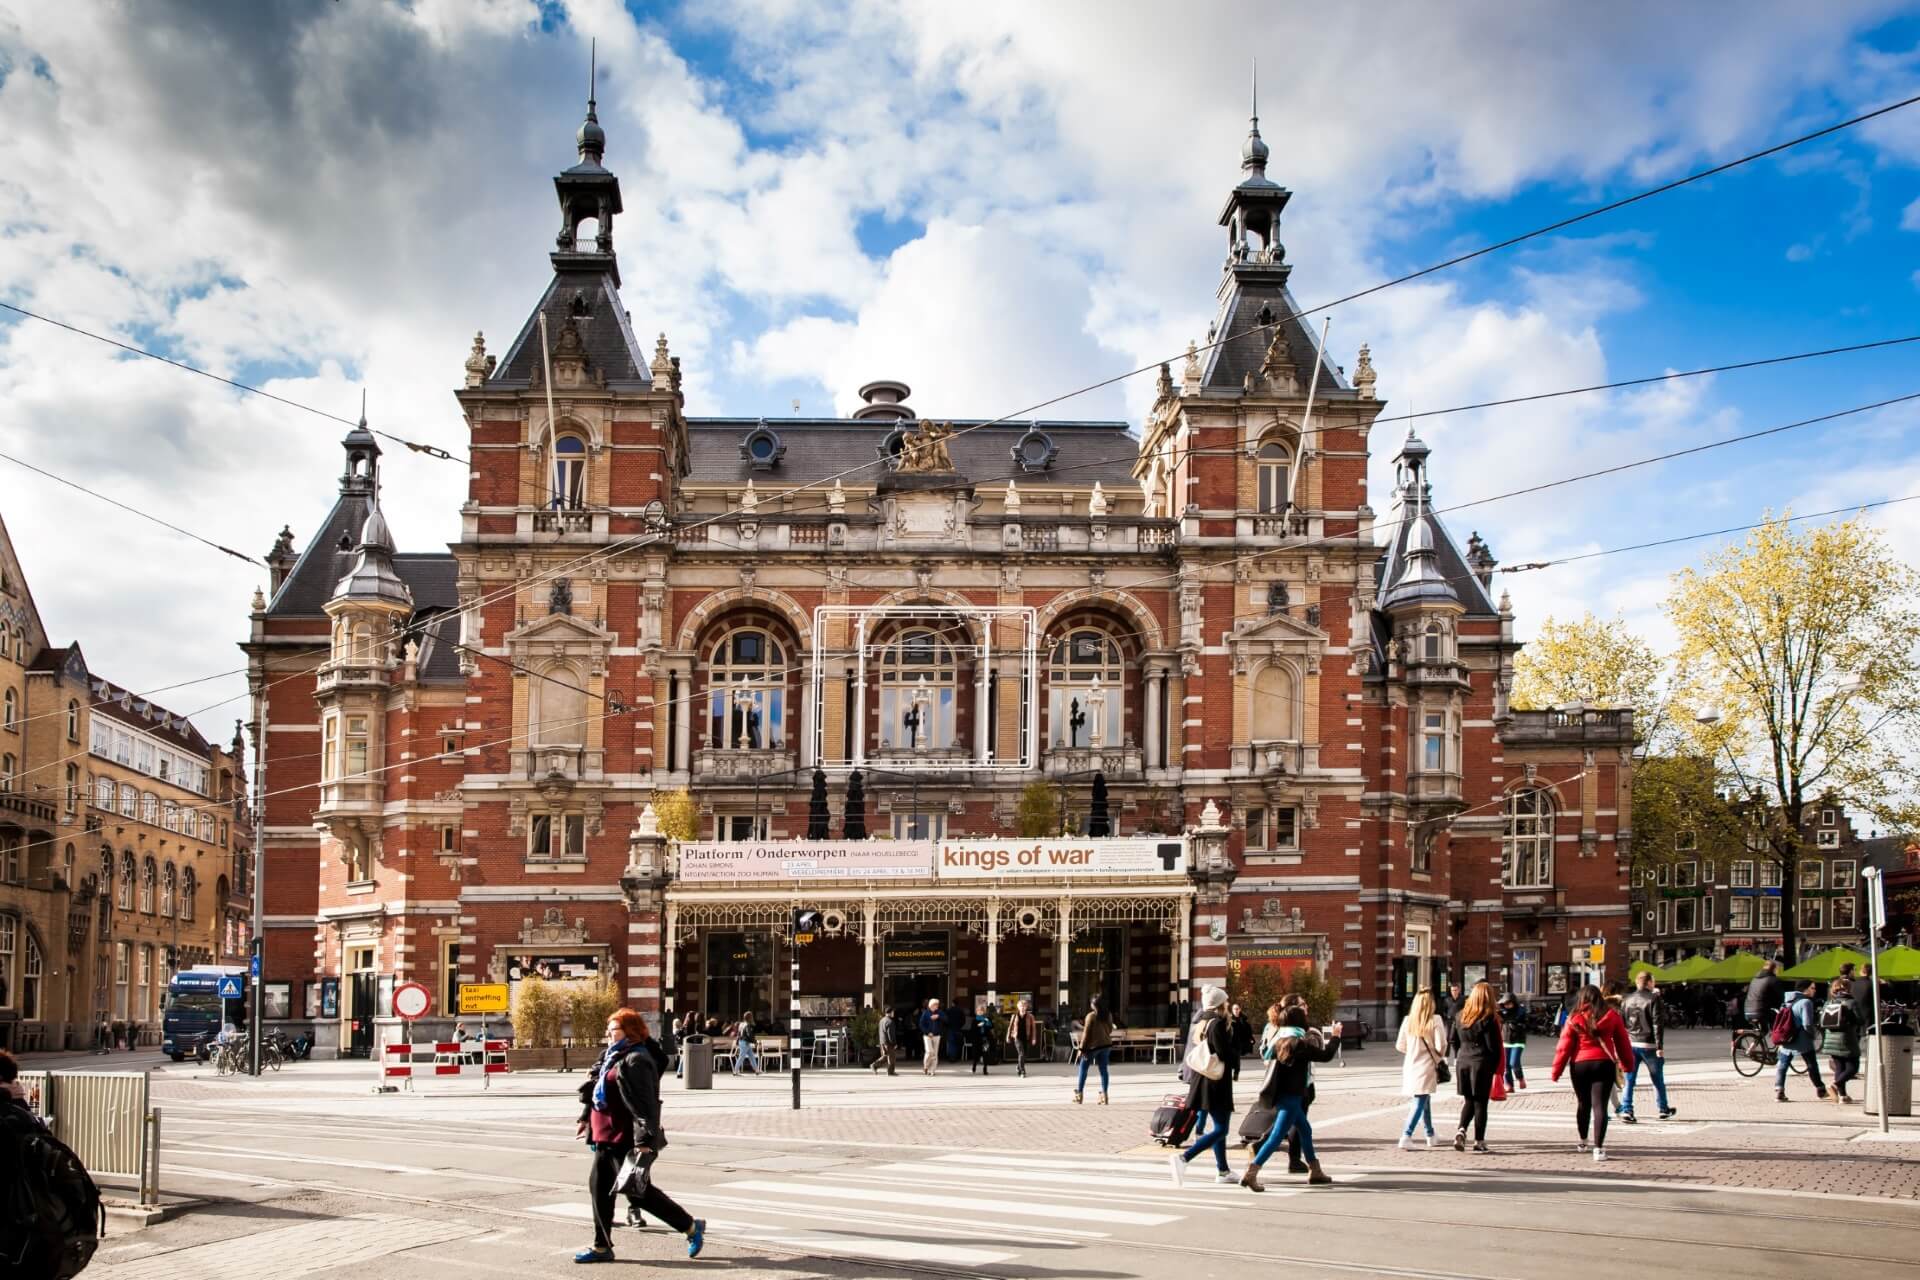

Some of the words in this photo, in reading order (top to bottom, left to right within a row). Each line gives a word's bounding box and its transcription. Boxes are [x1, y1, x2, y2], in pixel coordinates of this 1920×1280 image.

[685, 848, 744, 860] Platform
[756, 847, 847, 860] Onderworpen
[943, 846, 1010, 871] kings
[1017, 845, 1042, 865] of
[1048, 848, 1094, 865] war
